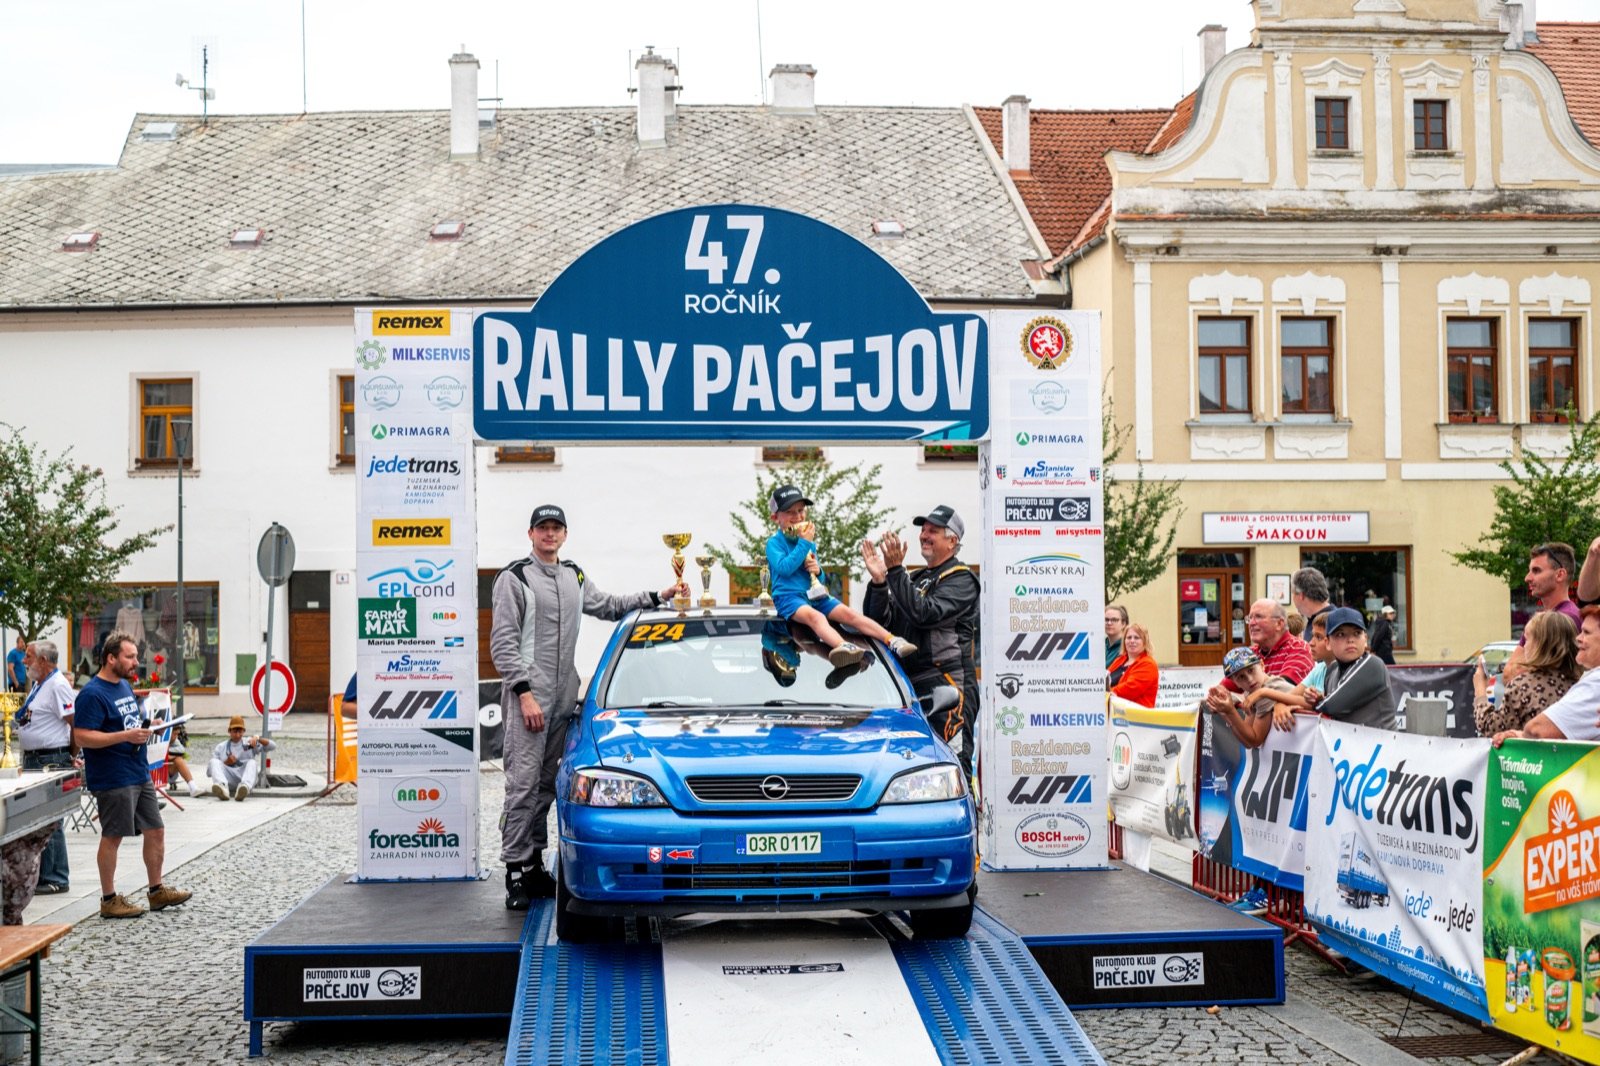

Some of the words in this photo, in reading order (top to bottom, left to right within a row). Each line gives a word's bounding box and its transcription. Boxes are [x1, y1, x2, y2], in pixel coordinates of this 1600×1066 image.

[686, 214, 782, 285] 47.
[687, 294, 782, 315] ROČNÍK
[392, 347, 470, 361] MILKSERVIS
[484, 315, 678, 412] RALLY
[694, 316, 981, 412] PAČEJOV
[390, 427, 450, 436] PRIMAGRA
[1032, 434, 1083, 444] PRIMAGRA
[1024, 467, 1048, 478] Musil
[1036, 460, 1075, 472] Stanislav
[1006, 498, 1038, 506] AUTOMOTO
[1007, 505, 1054, 521] PAČEJOV
[1220, 515, 1249, 523] KRMIVA
[1259, 514, 1314, 523] CHOVATELSKÉ
[1316, 513, 1352, 522] POTŘEBY
[1246, 525, 1327, 540] ŠMAKOUN
[1005, 565, 1058, 575] PLZEŇSKÝ
[1060, 566, 1085, 577] KRAJ
[378, 582, 455, 598] EPLcond
[1029, 587, 1074, 595] PRIMAGRA
[1009, 596, 1089, 614] Rezidence
[1010, 615, 1067, 632] Božkov
[630, 623, 686, 642] 224
[367, 638, 396, 647] Marius
[397, 638, 436, 647] Pedersen
[388, 661, 413, 672] Musil
[401, 655, 441, 666] Stanislav
[1028, 677, 1067, 686] ADVOKÁTNÍ
[1068, 677, 1105, 686] KANCELÁŘ
[1030, 713, 1105, 727] MILKSERVIS
[1011, 739, 1091, 757] Rezidence
[1011, 757, 1068, 775] Božkov
[1498, 755, 1543, 775] Trávníková
[1501, 774, 1527, 795] hnojiva,
[1502, 792, 1522, 812] osiva,
[369, 828, 460, 849] forestina
[749, 836, 777, 852] 03R
[780, 835, 819, 851] 0117
[1021, 831, 1061, 843] BOSCH
[1063, 834, 1085, 842] servis
[371, 849, 418, 860] ZAHRADNÍ
[421, 849, 460, 859] HNOJIVA
[736, 848, 749, 856] CZ
[1376, 833, 1404, 851] TUZEMSKÁ
[1412, 841, 1462, 861] MEZINÁRODNÍ
[1412, 859, 1445, 874] DOPRAVA
[1556, 889, 1566, 902] na
[1566, 880, 1581, 899] váš
[1095, 957, 1135, 968] AUTOMOTO
[1136, 956, 1156, 966] KLUB
[306, 969, 348, 980] AUTOMOTO
[350, 969, 371, 979] KLUB
[1095, 967, 1155, 987] PAČEJOV
[305, 979, 369, 1000] PAČEJOV
